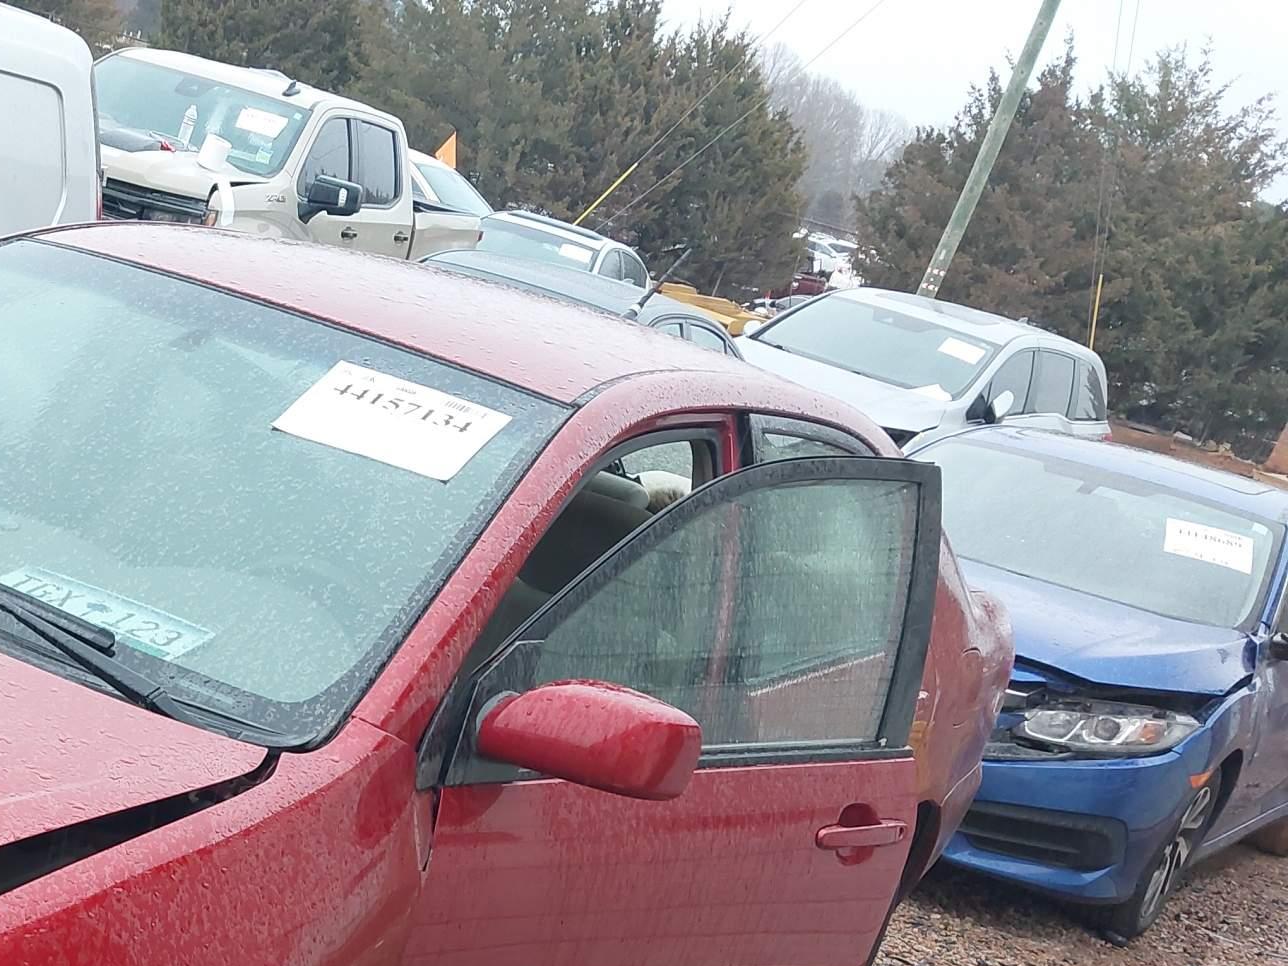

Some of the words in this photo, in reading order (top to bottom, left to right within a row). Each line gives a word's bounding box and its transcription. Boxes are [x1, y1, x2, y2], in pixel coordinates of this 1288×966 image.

[334, 384, 472, 432] 44157134
[14, 574, 86, 607] TGX
[101, 612, 183, 647] 123
